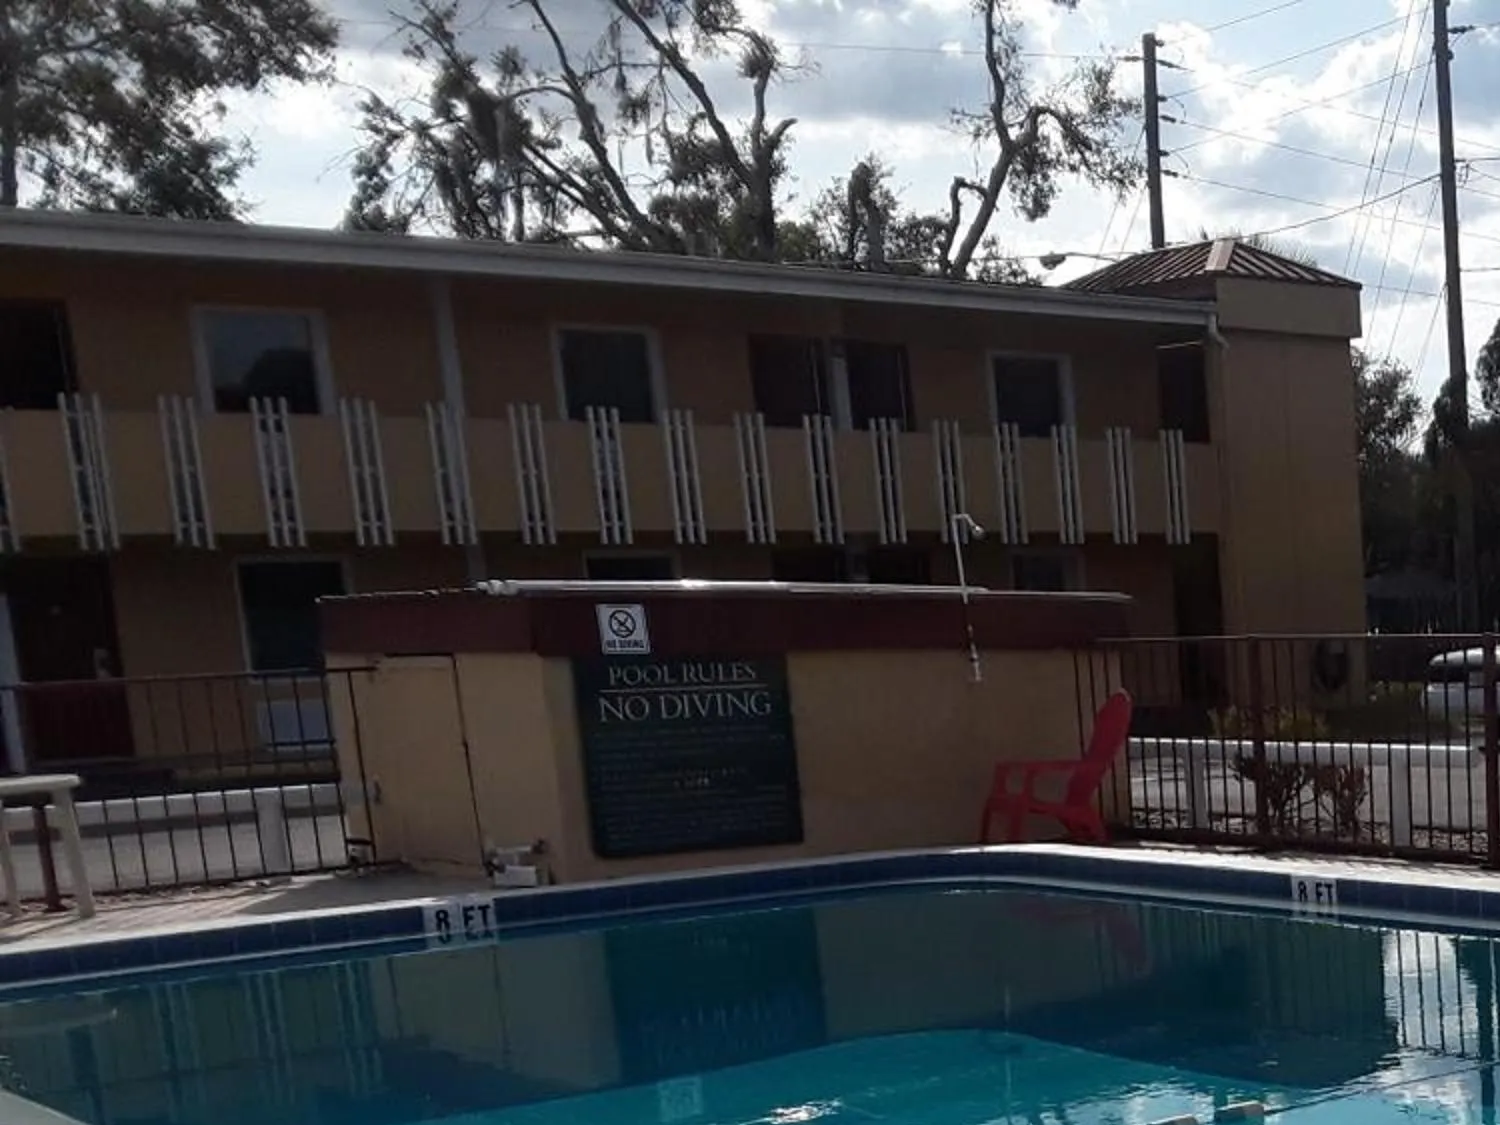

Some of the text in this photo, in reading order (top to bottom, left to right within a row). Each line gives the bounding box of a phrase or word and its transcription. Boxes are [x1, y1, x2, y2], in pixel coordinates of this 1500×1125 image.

[609, 662, 756, 685] POOL RULES
[599, 691, 772, 722] NO DIVING
[1315, 883, 1333, 907] FT
[462, 904, 491, 928] FT
